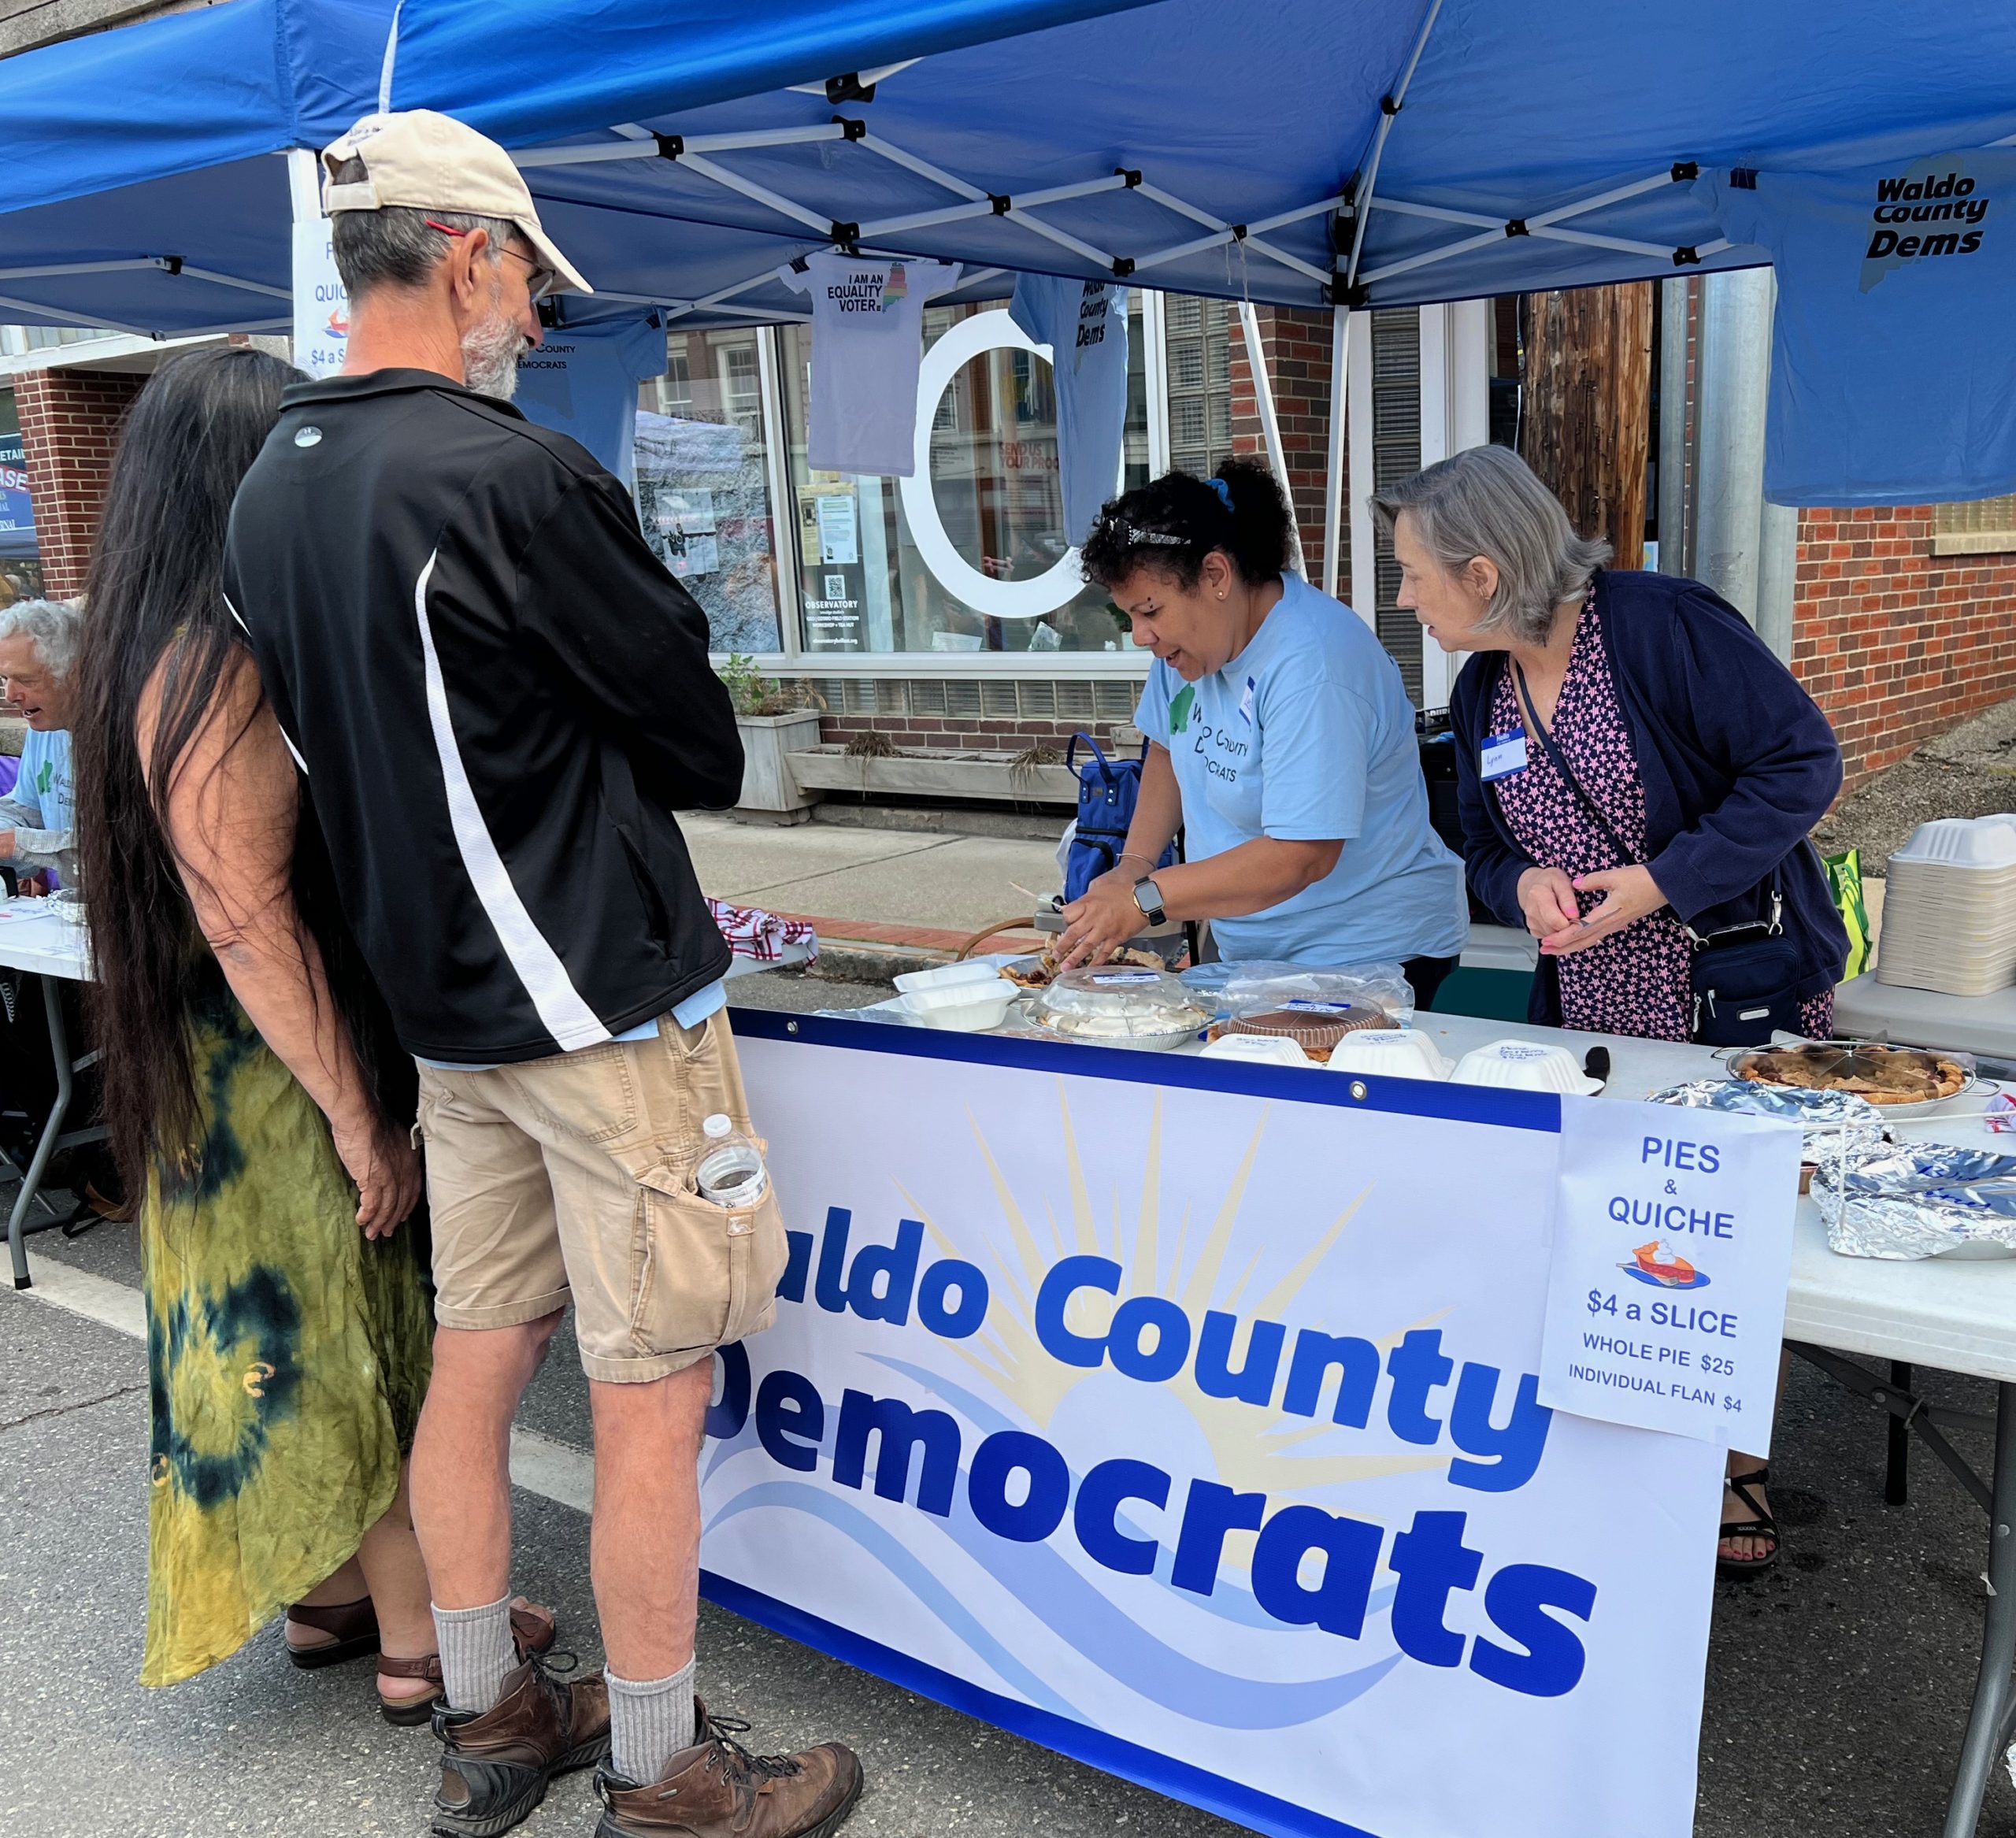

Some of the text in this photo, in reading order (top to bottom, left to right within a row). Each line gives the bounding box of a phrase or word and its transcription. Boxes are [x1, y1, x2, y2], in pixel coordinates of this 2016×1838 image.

[1877, 172, 1975, 202] Waldo
[1873, 198, 1990, 224] County
[1866, 230, 1984, 259] Dems
[849, 274, 883, 284] I AM AN
[316, 284, 347, 302] QUIC
[828, 285, 882, 299] EQUALITY
[1080, 298, 1109, 320] County
[1076, 324, 1106, 348] Dems
[517, 361, 567, 369] EMOCRATS
[0, 449, 25, 461] ETAIL
[999, 442, 1043, 456] SEND US
[999, 456, 1059, 470] YOUR PROO
[1642, 1136, 1720, 1174] PIES
[1664, 1179, 1677, 1195] &
[1608, 1196, 1735, 1240] QUICHE
[1587, 1288, 1738, 1339] $4 a SLICE
[775, 1206, 1550, 1494] aldo County
[1583, 1332, 1735, 1377] WHOLE PIE $25
[1569, 1363, 1743, 1413] INDIVIDUAL FLAN $4
